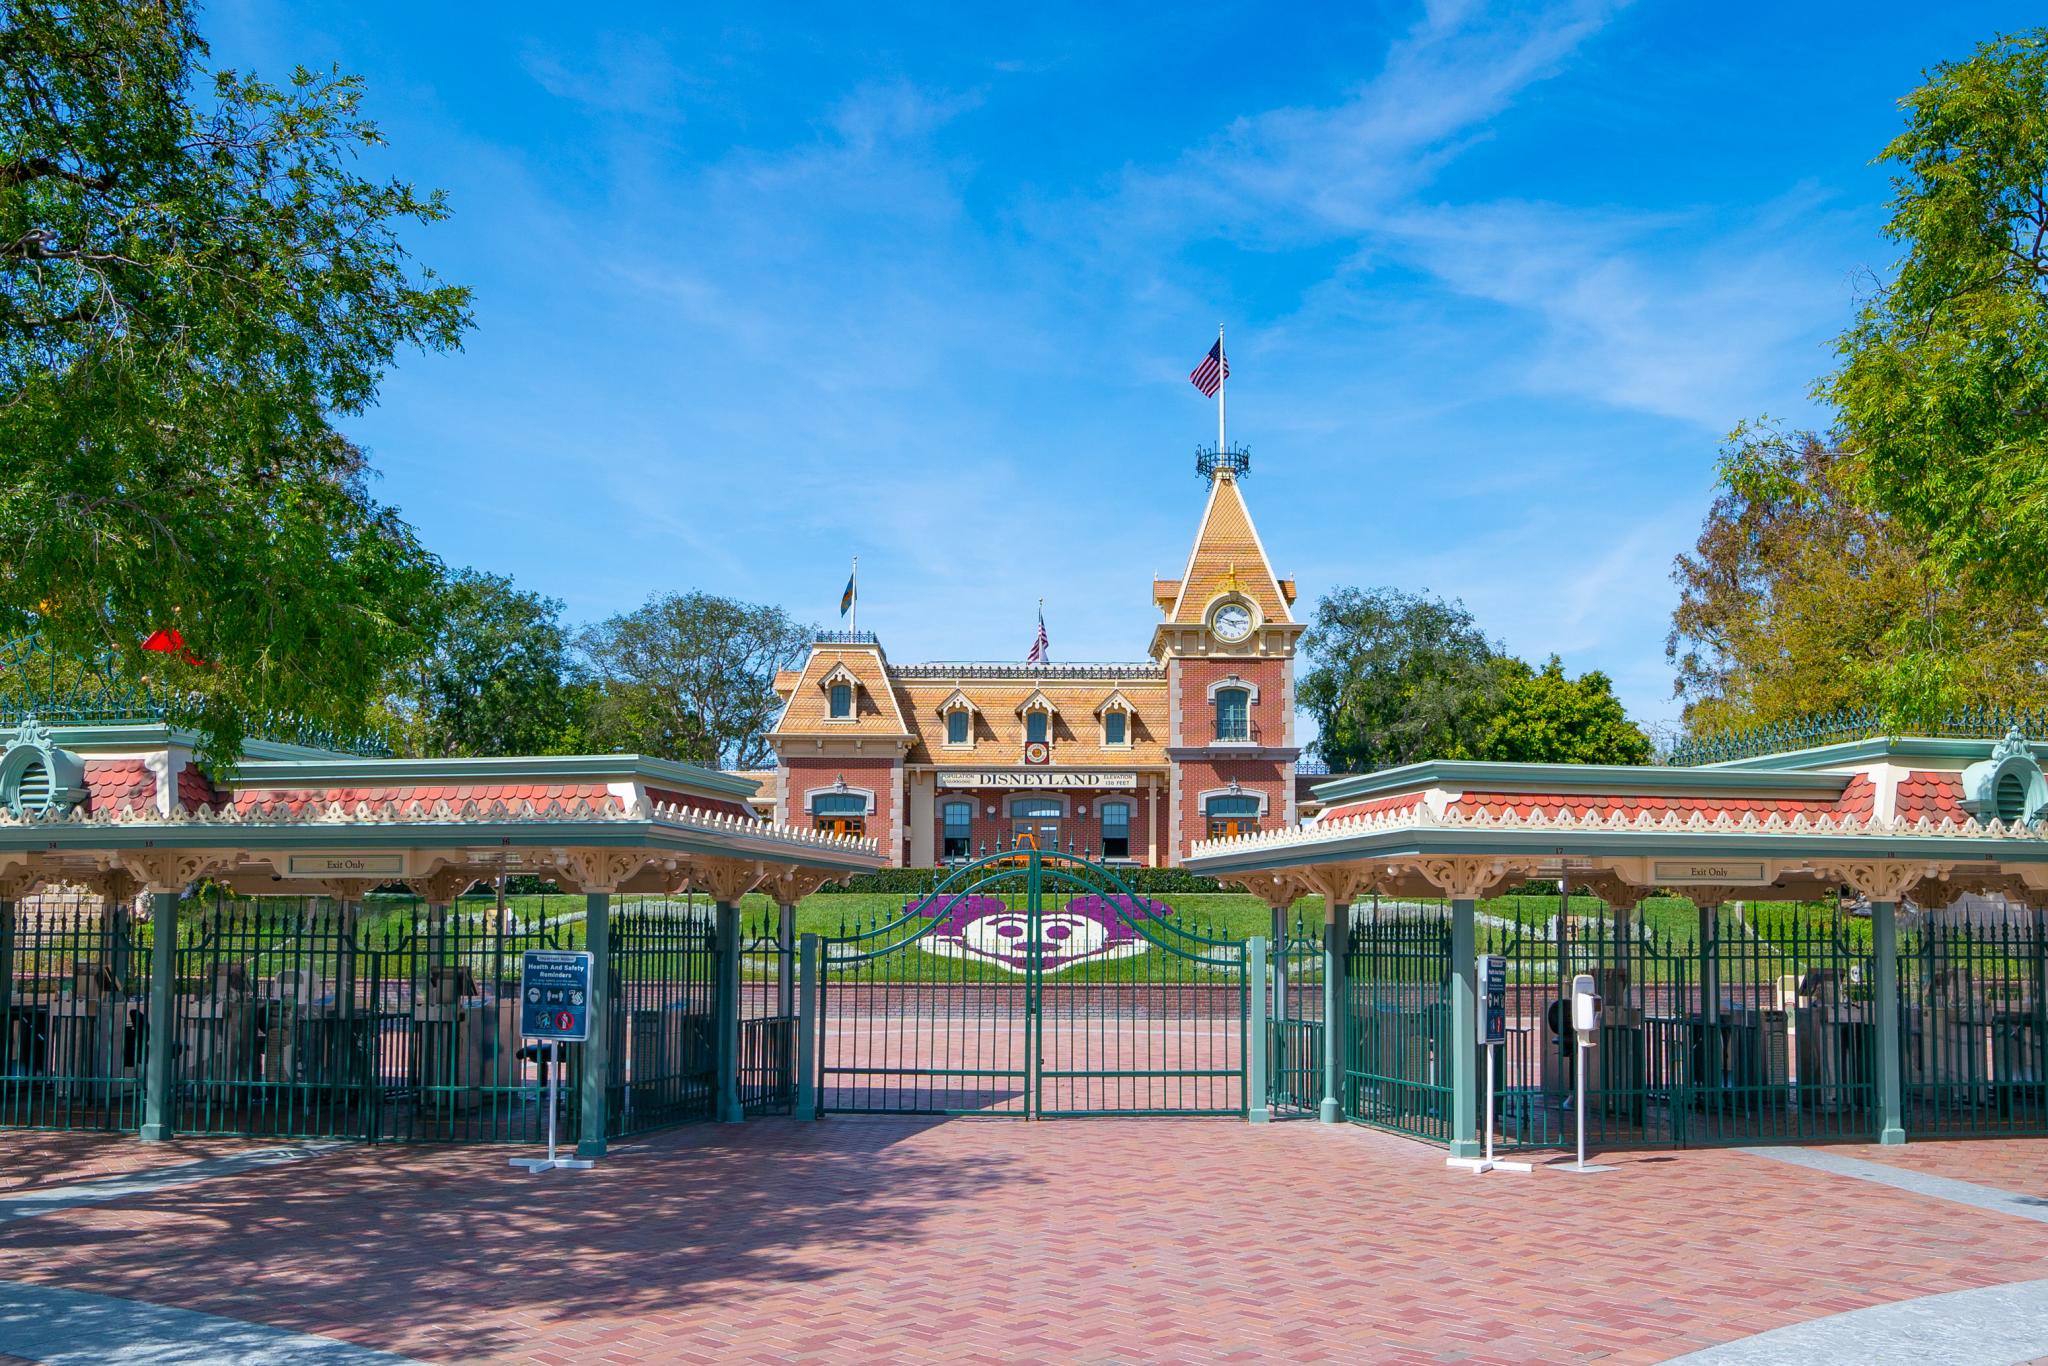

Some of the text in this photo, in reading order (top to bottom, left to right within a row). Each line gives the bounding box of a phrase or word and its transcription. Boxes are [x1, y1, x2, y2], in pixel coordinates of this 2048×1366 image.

[980, 774, 1100, 785] DISNEYLAND
[1555, 847, 1564, 855] 17
[327, 860, 365, 870] Exit Only
[1691, 867, 1729, 877] Exit Only
[564, 965, 585, 973] Safety
[539, 971, 573, 979] Reminders
